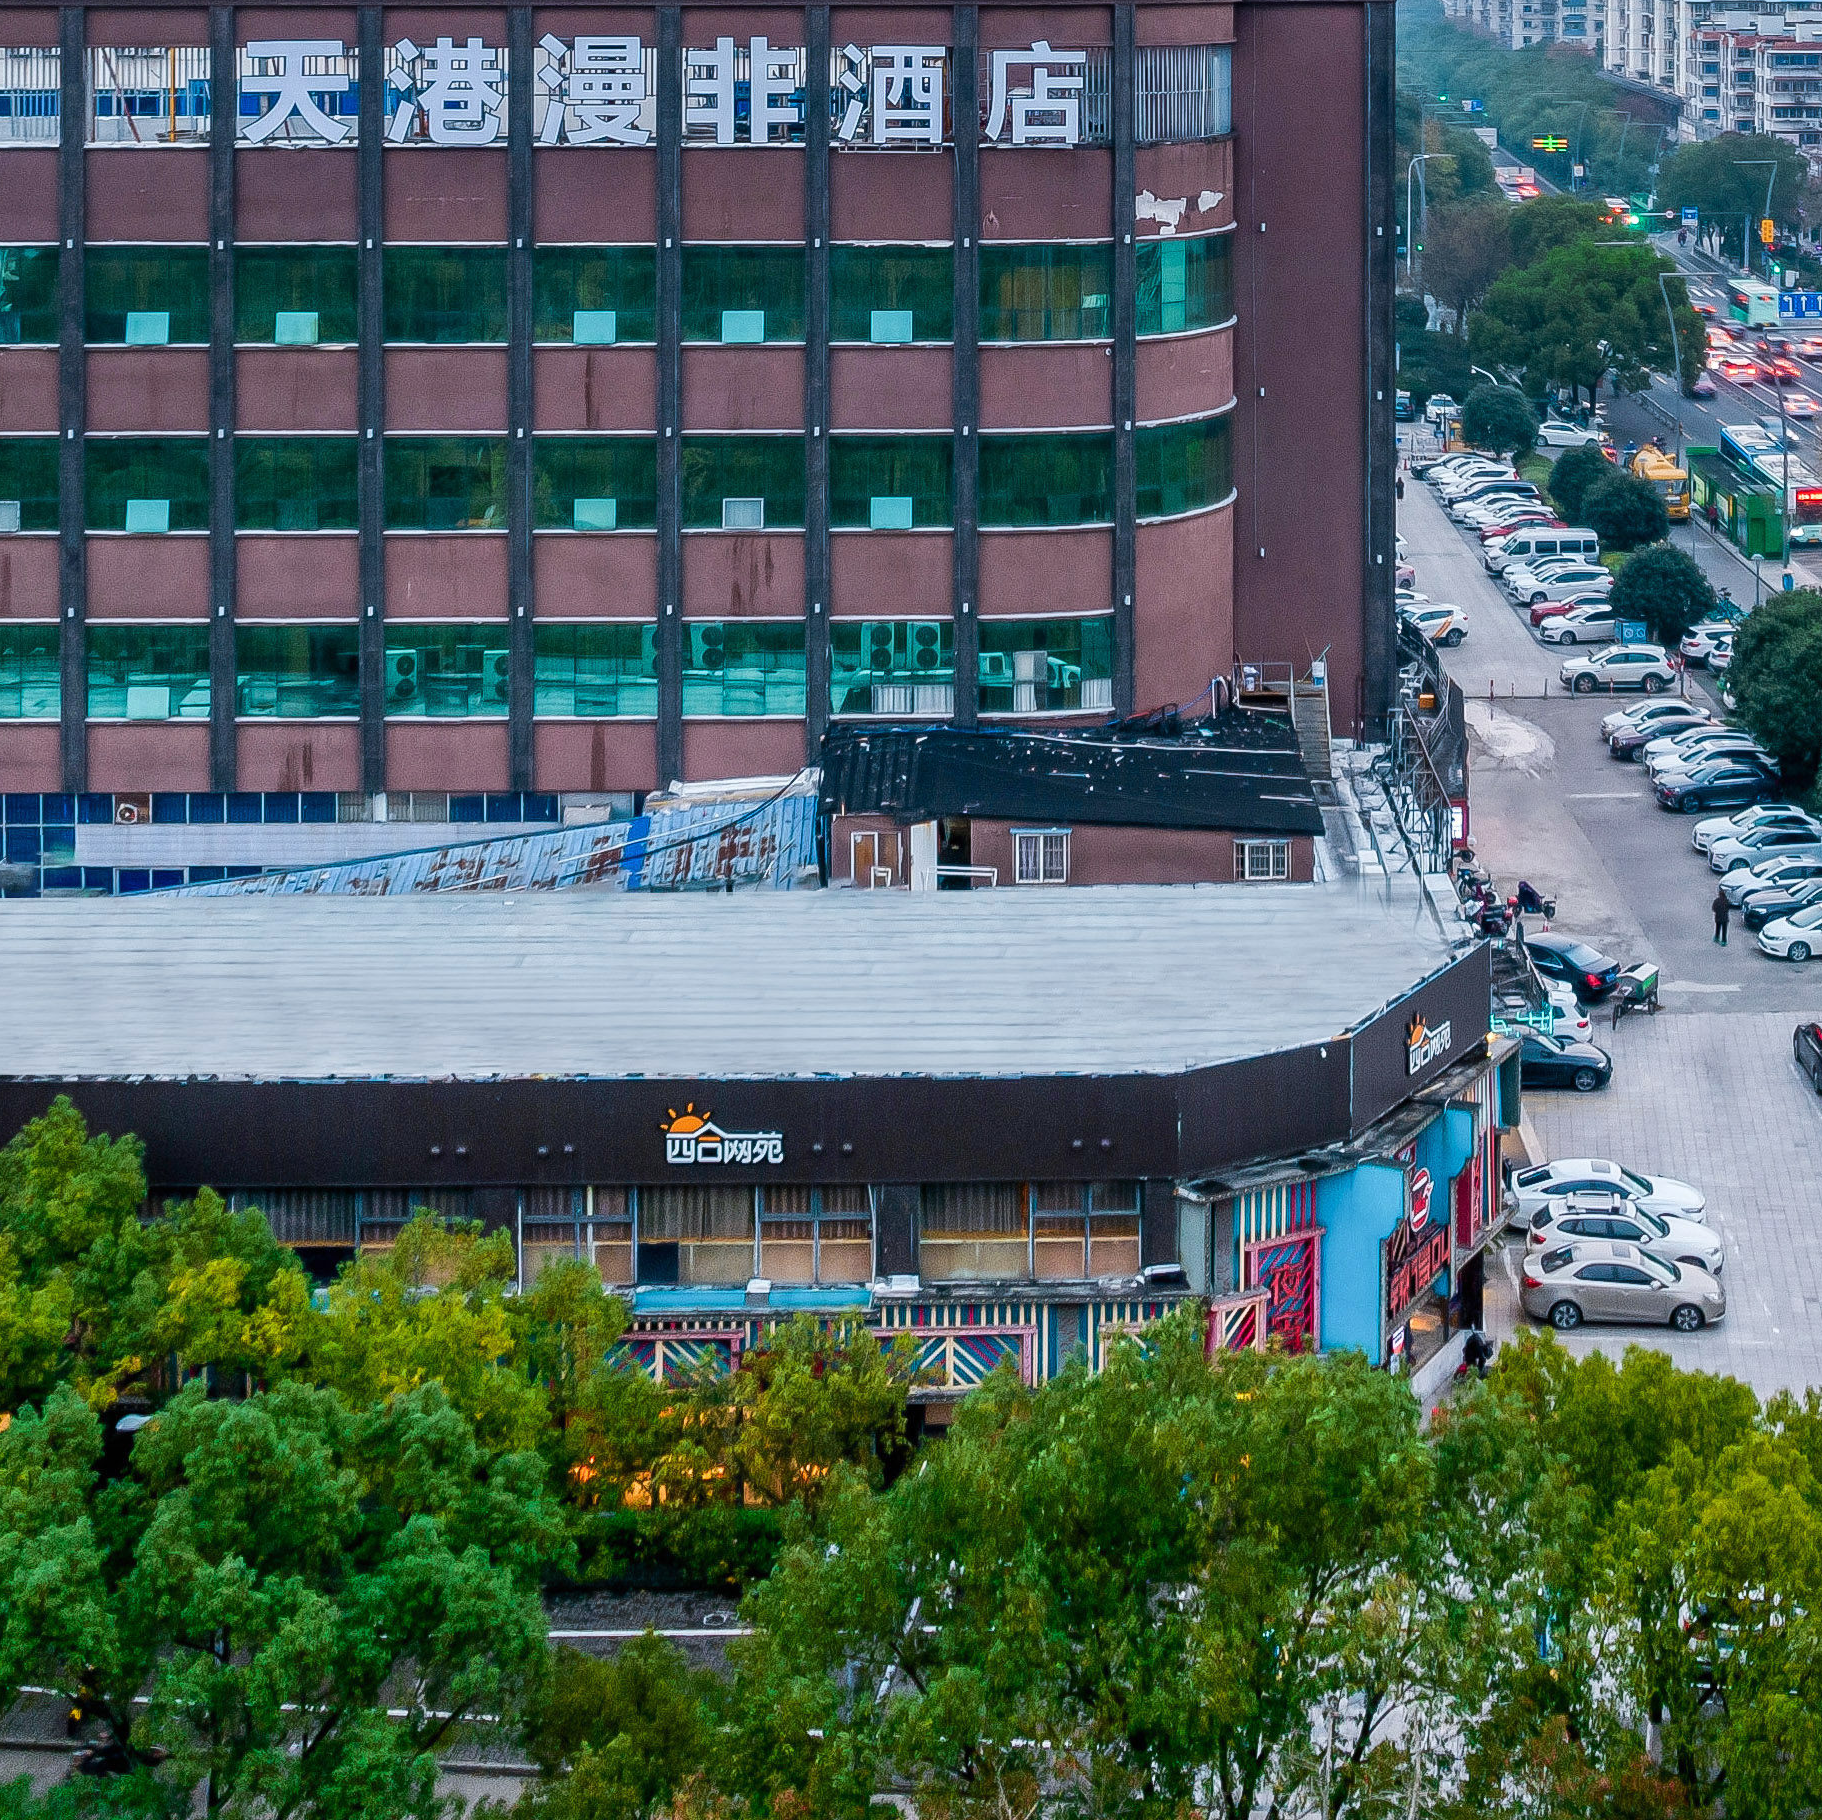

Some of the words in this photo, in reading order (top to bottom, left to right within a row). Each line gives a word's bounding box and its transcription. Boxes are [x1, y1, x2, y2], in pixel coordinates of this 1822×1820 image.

[241, 32, 1087, 146] 天港漫非酒店
[665, 1122, 783, 1164] 四合网苑
